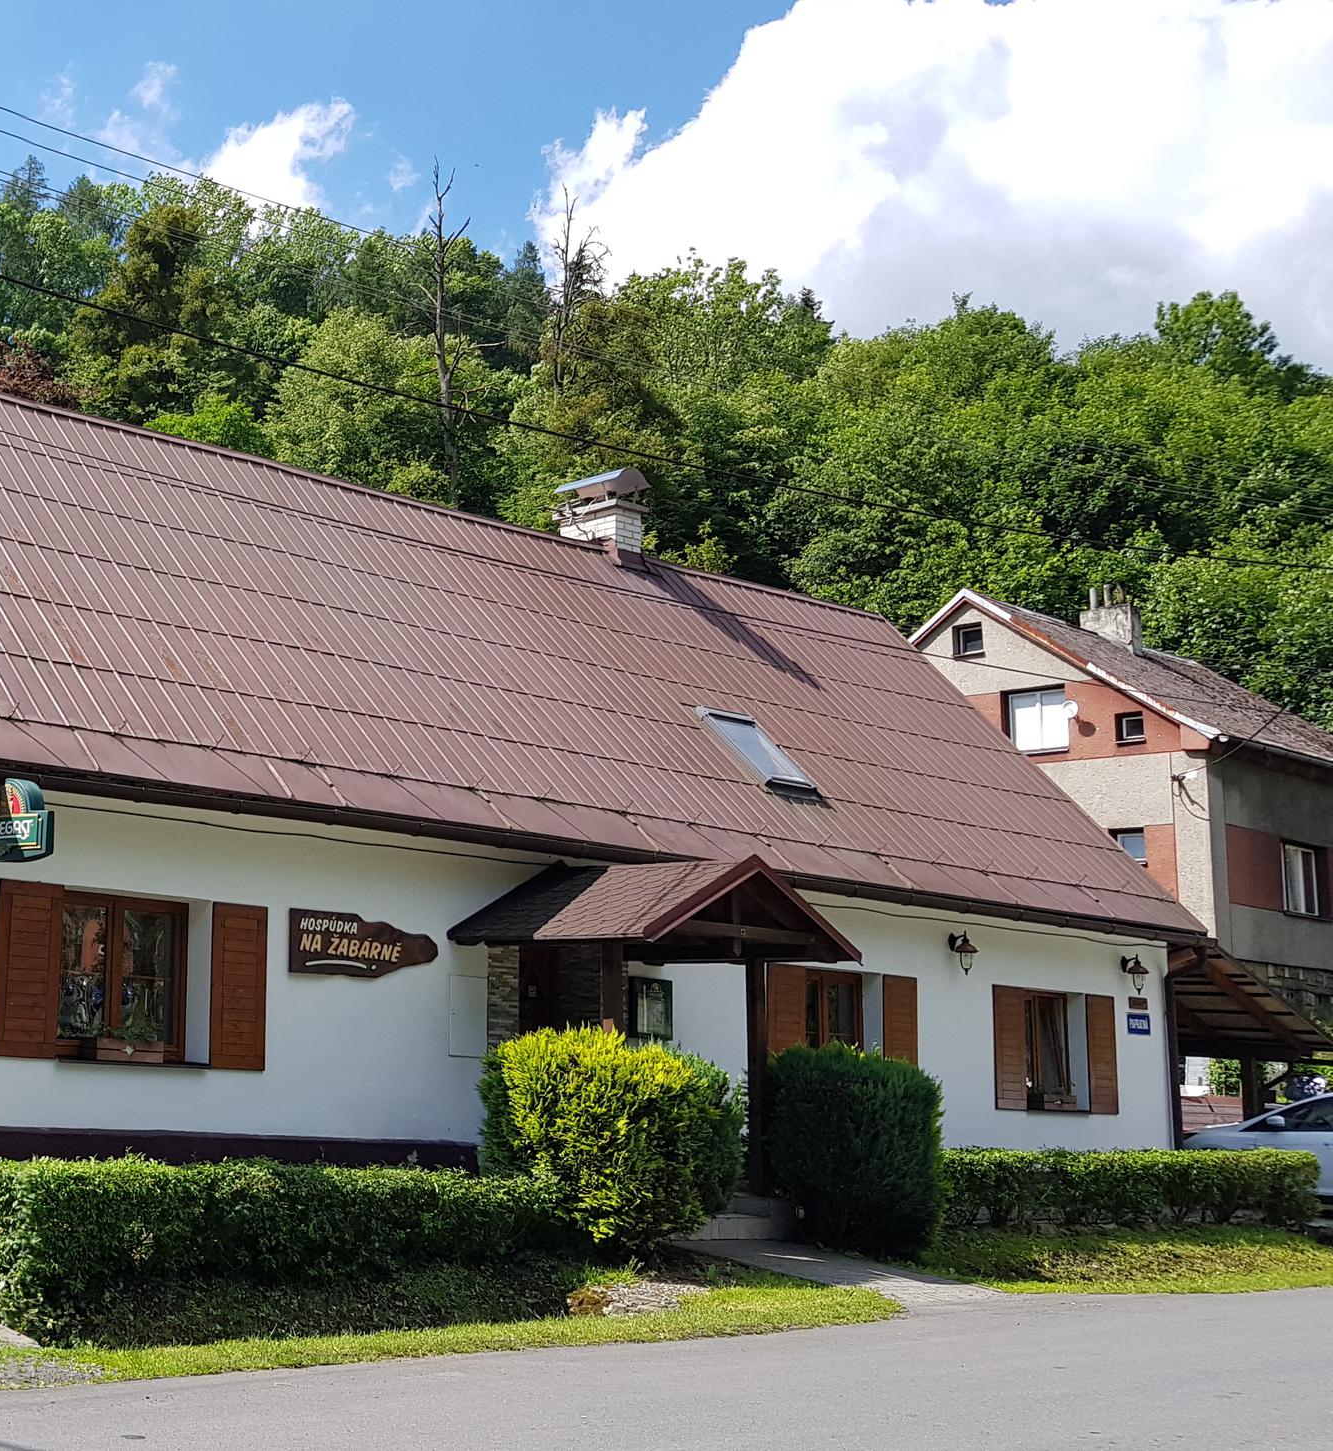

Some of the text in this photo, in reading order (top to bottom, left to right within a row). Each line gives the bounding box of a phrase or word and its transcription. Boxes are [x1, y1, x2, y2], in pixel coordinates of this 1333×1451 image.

[299, 917, 358, 934] HOSPŮDKA
[299, 932, 402, 963] NA ŽABÁRNĚ
